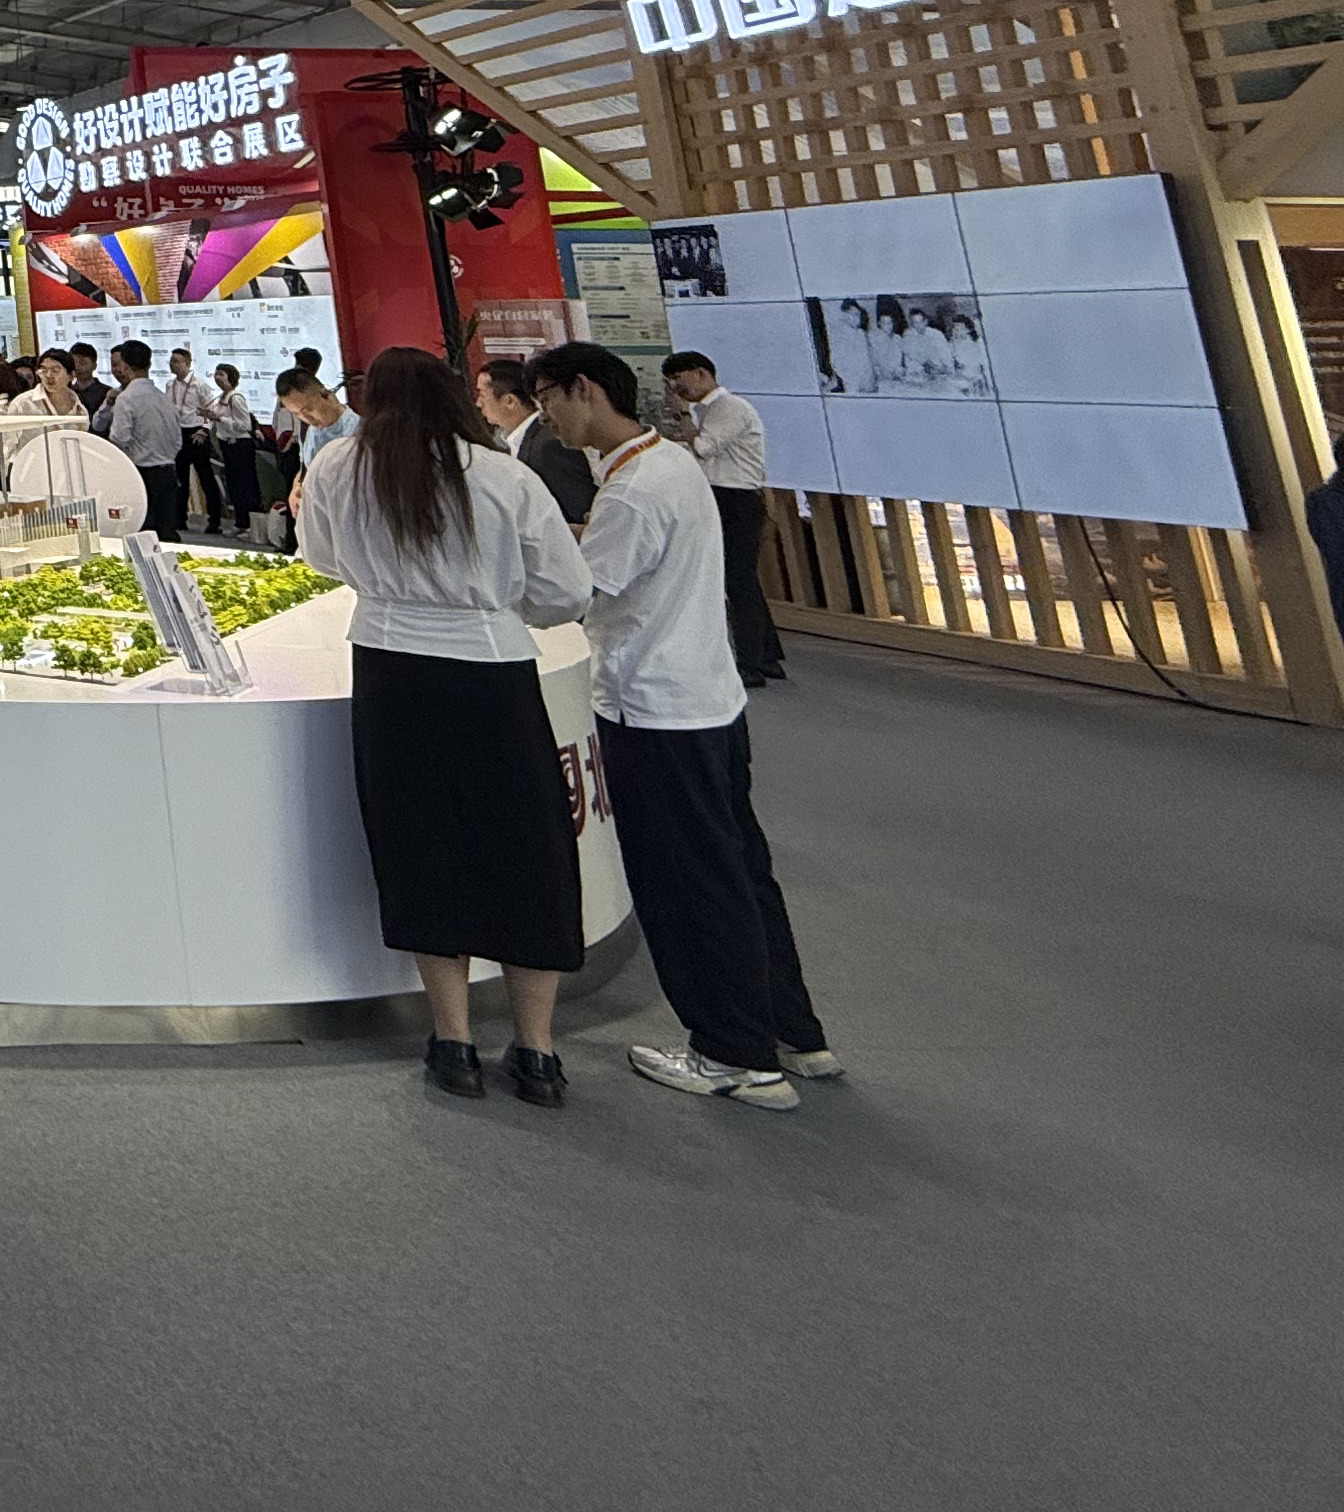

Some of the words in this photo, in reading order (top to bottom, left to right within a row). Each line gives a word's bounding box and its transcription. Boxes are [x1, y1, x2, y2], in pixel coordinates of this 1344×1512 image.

[72, 53, 295, 156] 好设计赋能好房子
